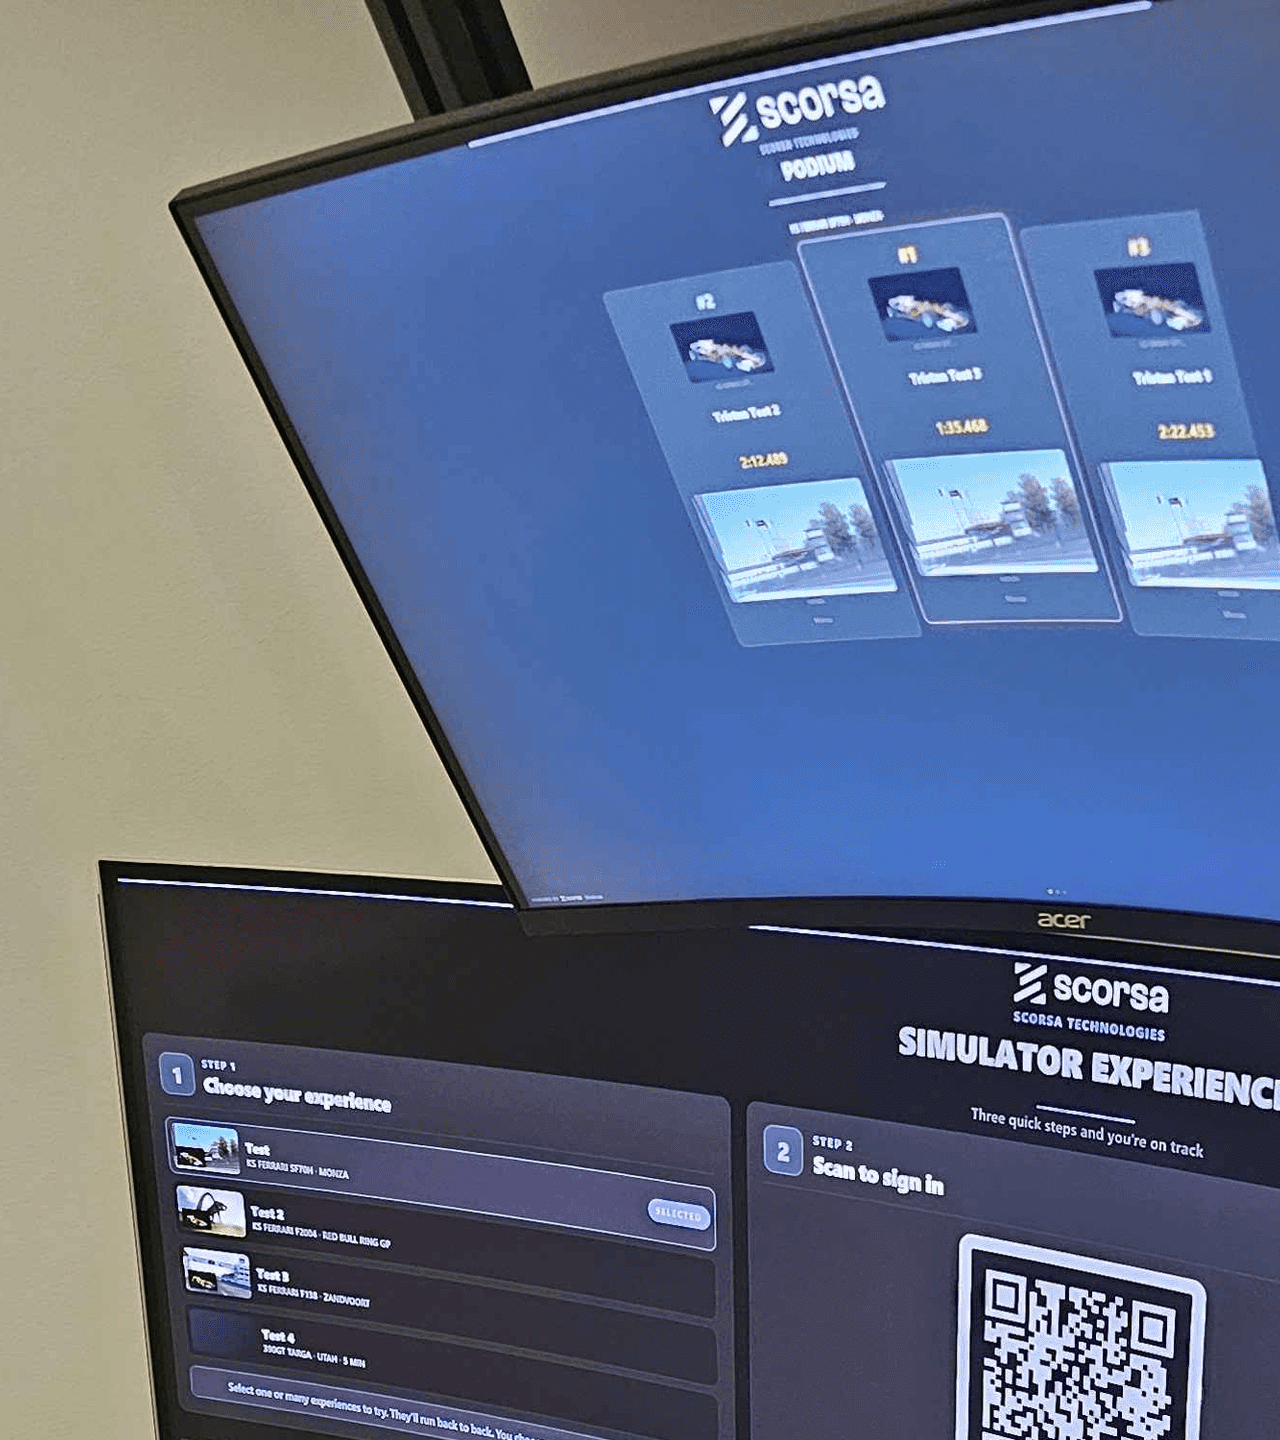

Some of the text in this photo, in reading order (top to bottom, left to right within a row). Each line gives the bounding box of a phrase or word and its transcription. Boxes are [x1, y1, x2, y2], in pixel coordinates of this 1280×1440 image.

[756, 75, 886, 129] scorsa
[780, 150, 856, 182] PODIUM
[1037, 912, 1092, 929] acer
[1053, 973, 1169, 1014] scorsa
[1013, 1010, 1166, 1042] SCORSA TECHNOLOGIES
[898, 1025, 1084, 1081] SIMULATOR
[172, 1066, 183, 1085] 1
[200, 1059, 237, 1072] STEP 1
[203, 1076, 393, 1114] Choose your experience
[812, 1135, 854, 1152] STEP 2
[970, 1106, 1204, 1159] Three quick steps and you're on track
[244, 1142, 271, 1157] Test
[777, 1142, 791, 1163] 2
[258, 1160, 289, 1172] FERRARI
[319, 1167, 350, 1180] MONZA
[813, 1155, 945, 1196] Scan to sign in
[250, 1205, 285, 1220] Test 2
[263, 1223, 294, 1235] FERRARI
[322, 1230, 339, 1241] RED
[339, 1233, 359, 1244] BULL
[359, 1236, 379, 1247] RING
[379, 1238, 391, 1249] GP
[256, 1267, 282, 1282] Test
[268, 1285, 299, 1297] FERRARI
[323, 1292, 370, 1308] ZANDVOORT
[261, 1328, 295, 1344] Test 4
[287, 1347, 366, 1368] TARGA UTAH MIN
[227, 1382, 255, 1396] Select
[255, 1387, 273, 1399] one
[273, 1390, 285, 1401] or
[285, 1392, 310, 1407] many
[310, 1397, 362, 1414] experiences
[362, 1404, 373, 1415] to
[373, 1407, 389, 1421] try.
[389, 1408, 419, 1424] They'll
[419, 1415, 436, 1427] run
[437, 1415, 459, 1431] back
[459, 1421, 470, 1433] to
[470, 1423, 495, 1439] back.
